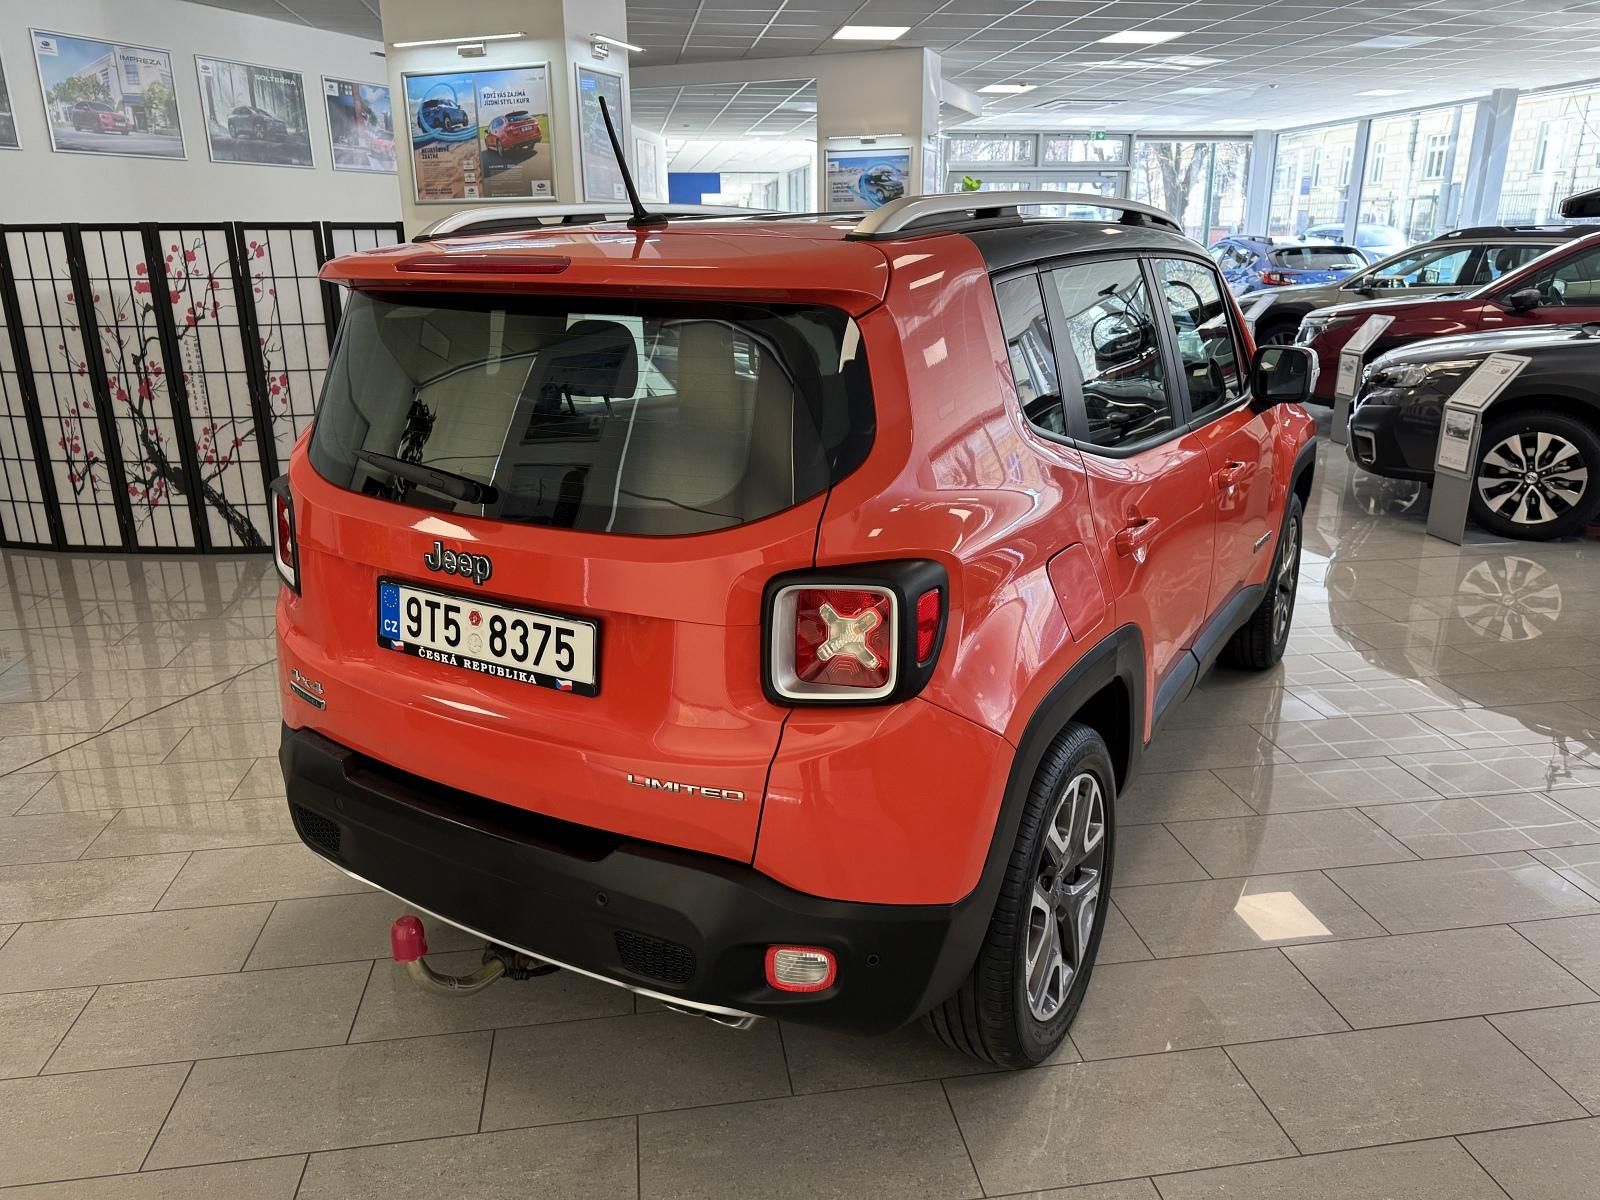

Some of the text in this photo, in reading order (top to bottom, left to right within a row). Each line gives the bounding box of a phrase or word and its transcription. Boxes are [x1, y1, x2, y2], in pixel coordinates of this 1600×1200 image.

[119, 54, 162, 66] IMPREZA
[254, 74, 296, 86] SOLTERRA
[424, 541, 492, 585] Jeep
[384, 619, 398, 633] CZ
[406, 596, 575, 672] 9T5 8375
[418, 646, 537, 685] ČESKÁ REPUBLIKA
[627, 774, 745, 801] LIMITED
